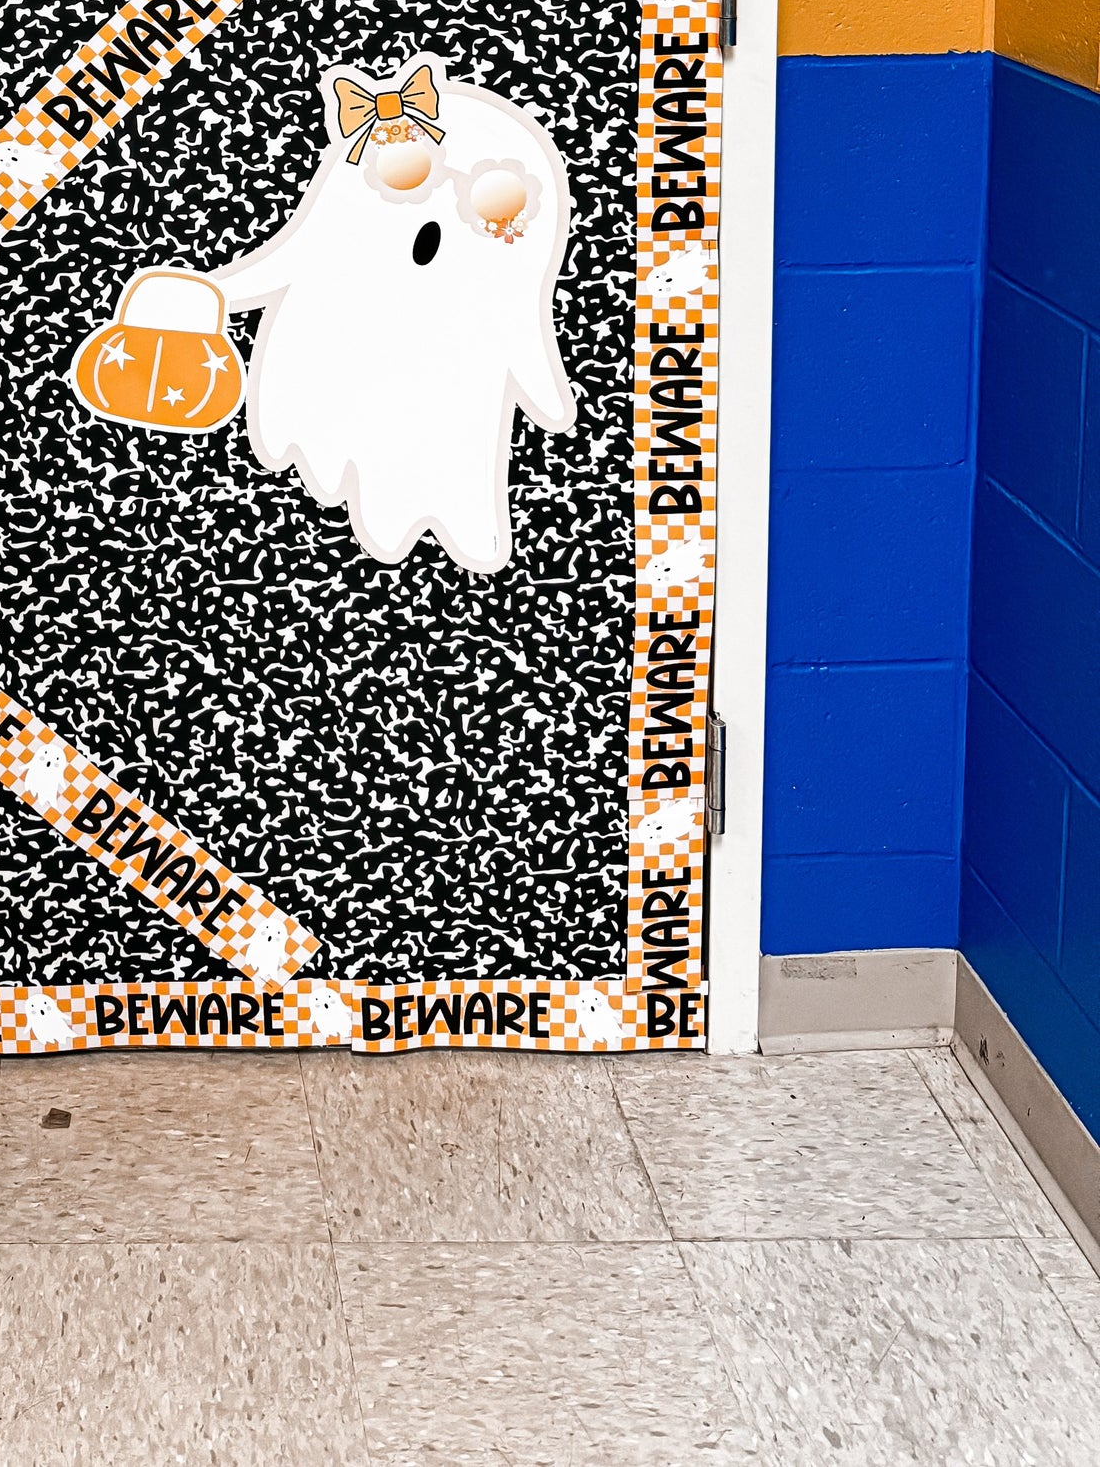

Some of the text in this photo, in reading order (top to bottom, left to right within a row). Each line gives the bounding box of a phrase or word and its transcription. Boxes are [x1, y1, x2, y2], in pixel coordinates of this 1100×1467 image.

[652, 33, 709, 233] BEWARE
[649, 322, 704, 515] BEWARE
[641, 610, 699, 790] BEWARE
[71, 789, 247, 934] BEWARE
[95, 991, 284, 1036] BEWARE
[361, 991, 551, 1041] BEWARE
[647, 993, 709, 1038] BE
